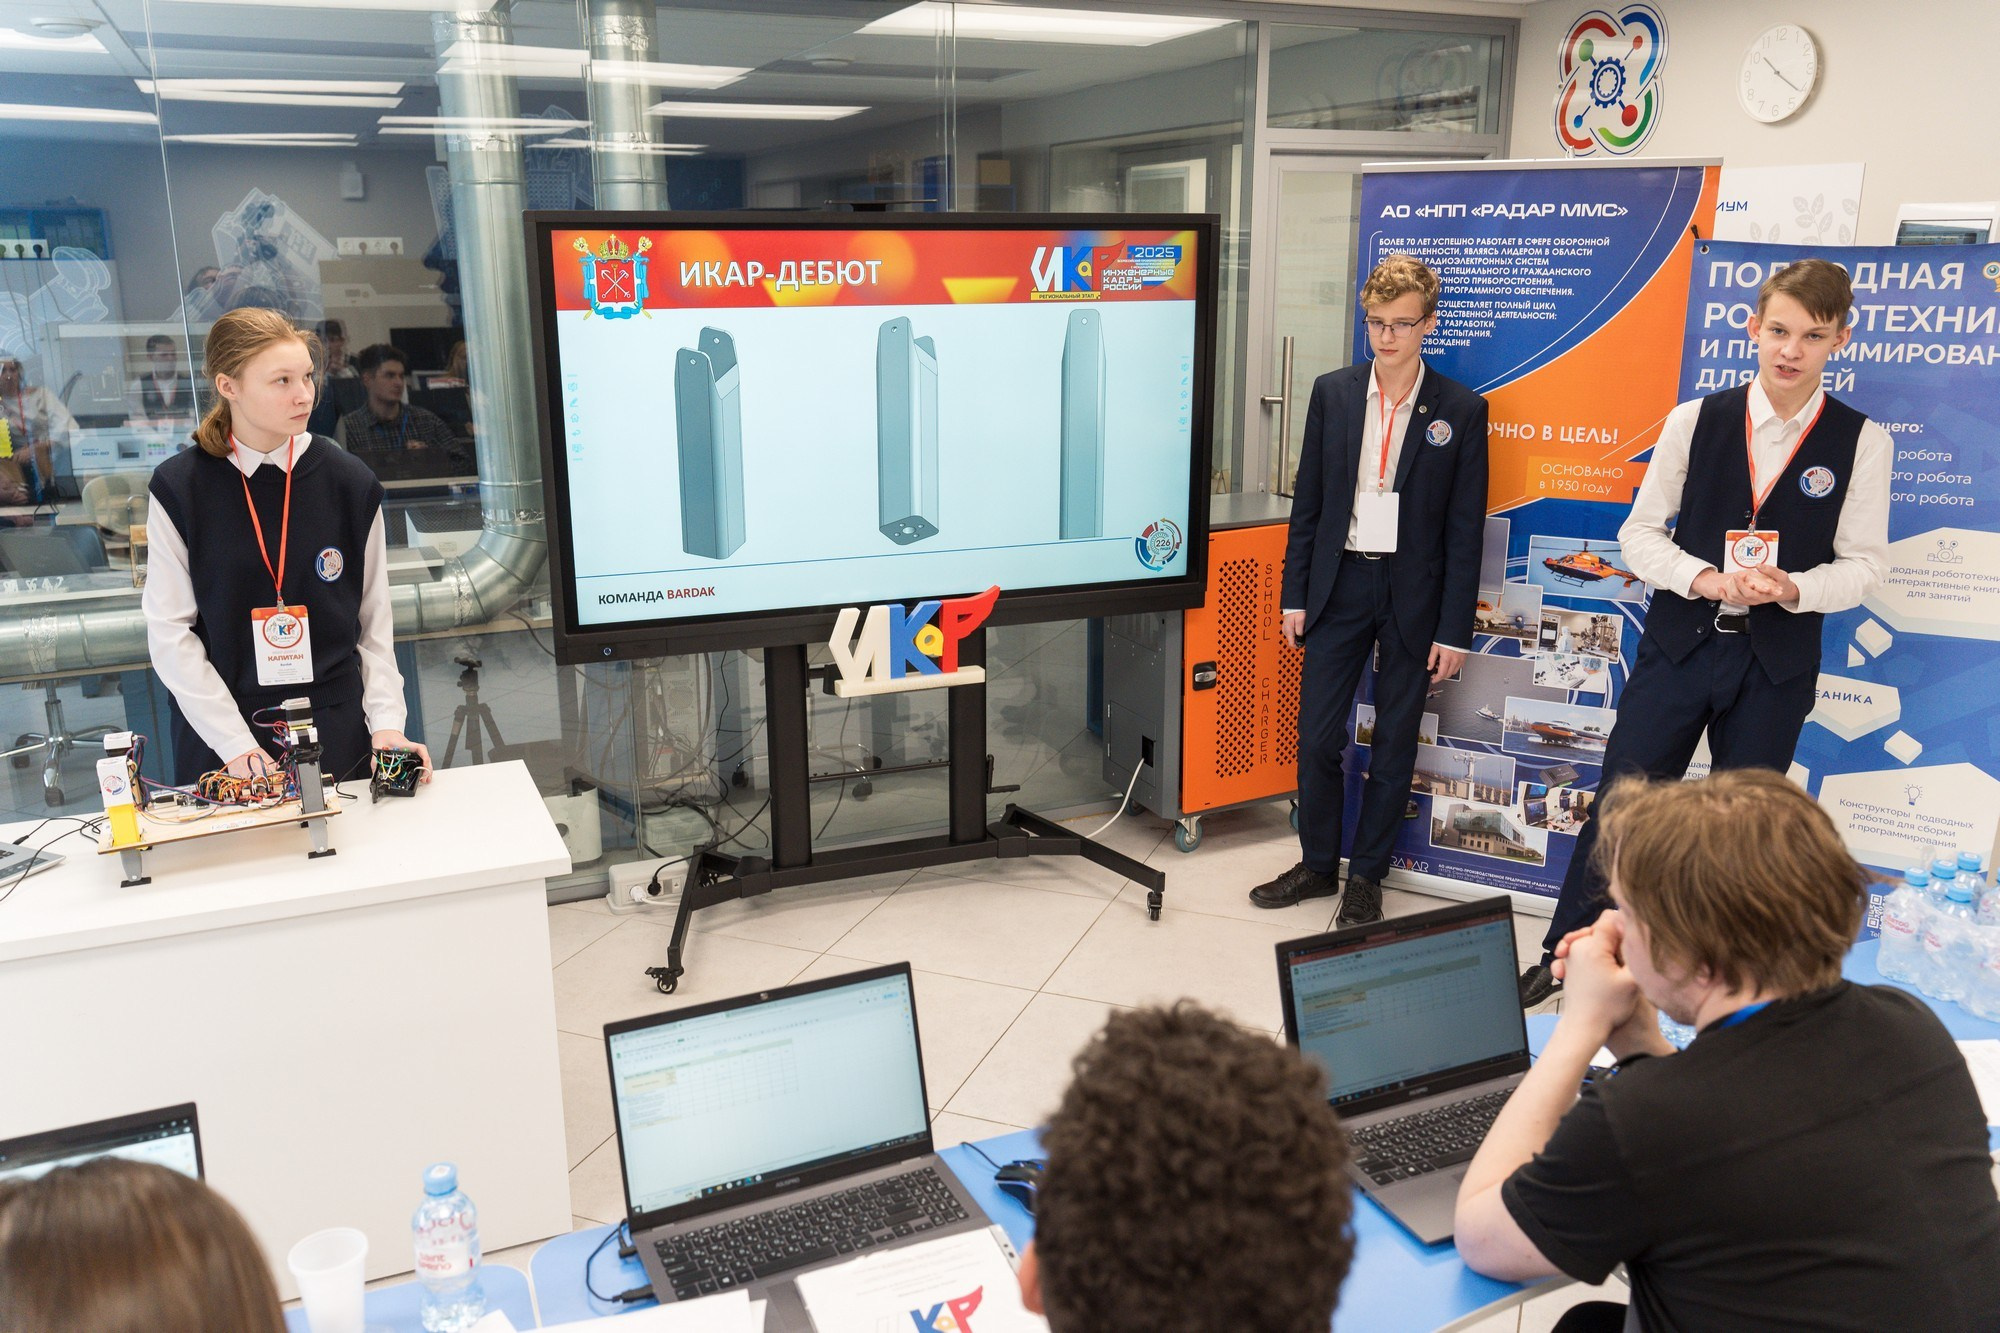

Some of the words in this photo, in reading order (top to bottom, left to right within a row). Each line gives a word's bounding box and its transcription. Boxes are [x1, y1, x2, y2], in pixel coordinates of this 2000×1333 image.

[1380, 204, 1411, 218] АО
[1415, 203, 1467, 218] «НПП
[1471, 203, 1556, 220] «РАДАР
[1560, 203, 1629, 217] ММС»
[1379, 238, 1405, 246] БОЛЕЕ
[1406, 238, 1416, 246] 70
[1417, 238, 1432, 246] ЛЕТ
[1432, 238, 1475, 246] УСПЕШНО
[1476, 238, 1516, 246] РАБОТАЕТ
[1517, 238, 1523, 246] В
[1524, 237, 1551, 246] СФЕРЕ
[1553, 237, 1610, 246] ОБОРОННОЙ
[1134, 247, 1175, 258] 2025
[1378, 247, 1461, 256] ПРОМЫШЛЕННОСТИ,
[1463, 247, 1499, 256] ЯВЛЯЯСЬ
[1500, 247, 1543, 256] ЛИДЕРОМ
[1544, 248, 1550, 256] В
[1551, 248, 1593, 256] ОБЛАСТИ
[1424, 257, 1513, 266] РАДИОЭЛЕКТРОННЫХ
[1515, 258, 1549, 266] СИСТЕМ
[679, 260, 883, 292] ИКАР-ДЕБЮТ
[1443, 267, 1510, 276] СПЕЦИАЛЬНОГО
[1520, 267, 1592, 277] ГРАЖДАНСКОГО
[1709, 261, 1965, 294] ПОДНАЯ
[1103, 276, 1142, 284] КАДРЫ
[1471, 277, 1555, 286] ПРИБОРОСТРОЕНИЯ,
[1103, 283, 1142, 291] РОССИИ
[1444, 286, 1512, 295] ПРОГРАММНОГО
[1513, 287, 1575, 296] ОБЕСПЕЧЕНИЯ.
[1494, 300, 1531, 310] ПОЛНЫЙ
[1532, 302, 1556, 311] ЦИКЛ
[1435, 309, 1493, 319] ВОДСТВЕННОЙ
[1494, 310, 1558, 321] ДЕЯТЕЛЬНОСТИ:
[1444, 319, 1497, 329] РАЗРАБОТКИ,
[1442, 329, 1493, 339] ИСПЫТАНИЯ,
[1700, 339, 1719, 359] И
[1542, 424, 1553, 441] В
[1559, 425, 1619, 445] ЦЕЛЬ!
[1897, 449, 1953, 462] робота
[1541, 463, 1624, 479] ОСНОВАНО
[1917, 471, 1972, 485] робота
[1539, 480, 1546, 489] в
[1551, 479, 1580, 492] 1950
[1582, 483, 1613, 496] году
[1919, 493, 1975, 507] робота
[1156, 539, 1171, 547] 226
[1889, 567, 1930, 576] водная
[1888, 577, 1971, 592] интерактивные
[598, 590, 664, 606] КОМАНДА
[667, 586, 716, 601] BARDAK
[1262, 563, 1274, 642] SCHOOL
[1906, 590, 1926, 599] для
[1928, 593, 1971, 603] занятий
[267, 653, 304, 662] КАПИТАН
[1260, 676, 1271, 765] CHARGER
[1839, 798, 1911, 819] Конструкторы
[1915, 813, 1974, 830] подводных
[1852, 811, 1895, 826] роботов
[1896, 822, 1915, 831] для
[1917, 824, 1956, 838] сборки
[1857, 824, 1957, 849] программирования
